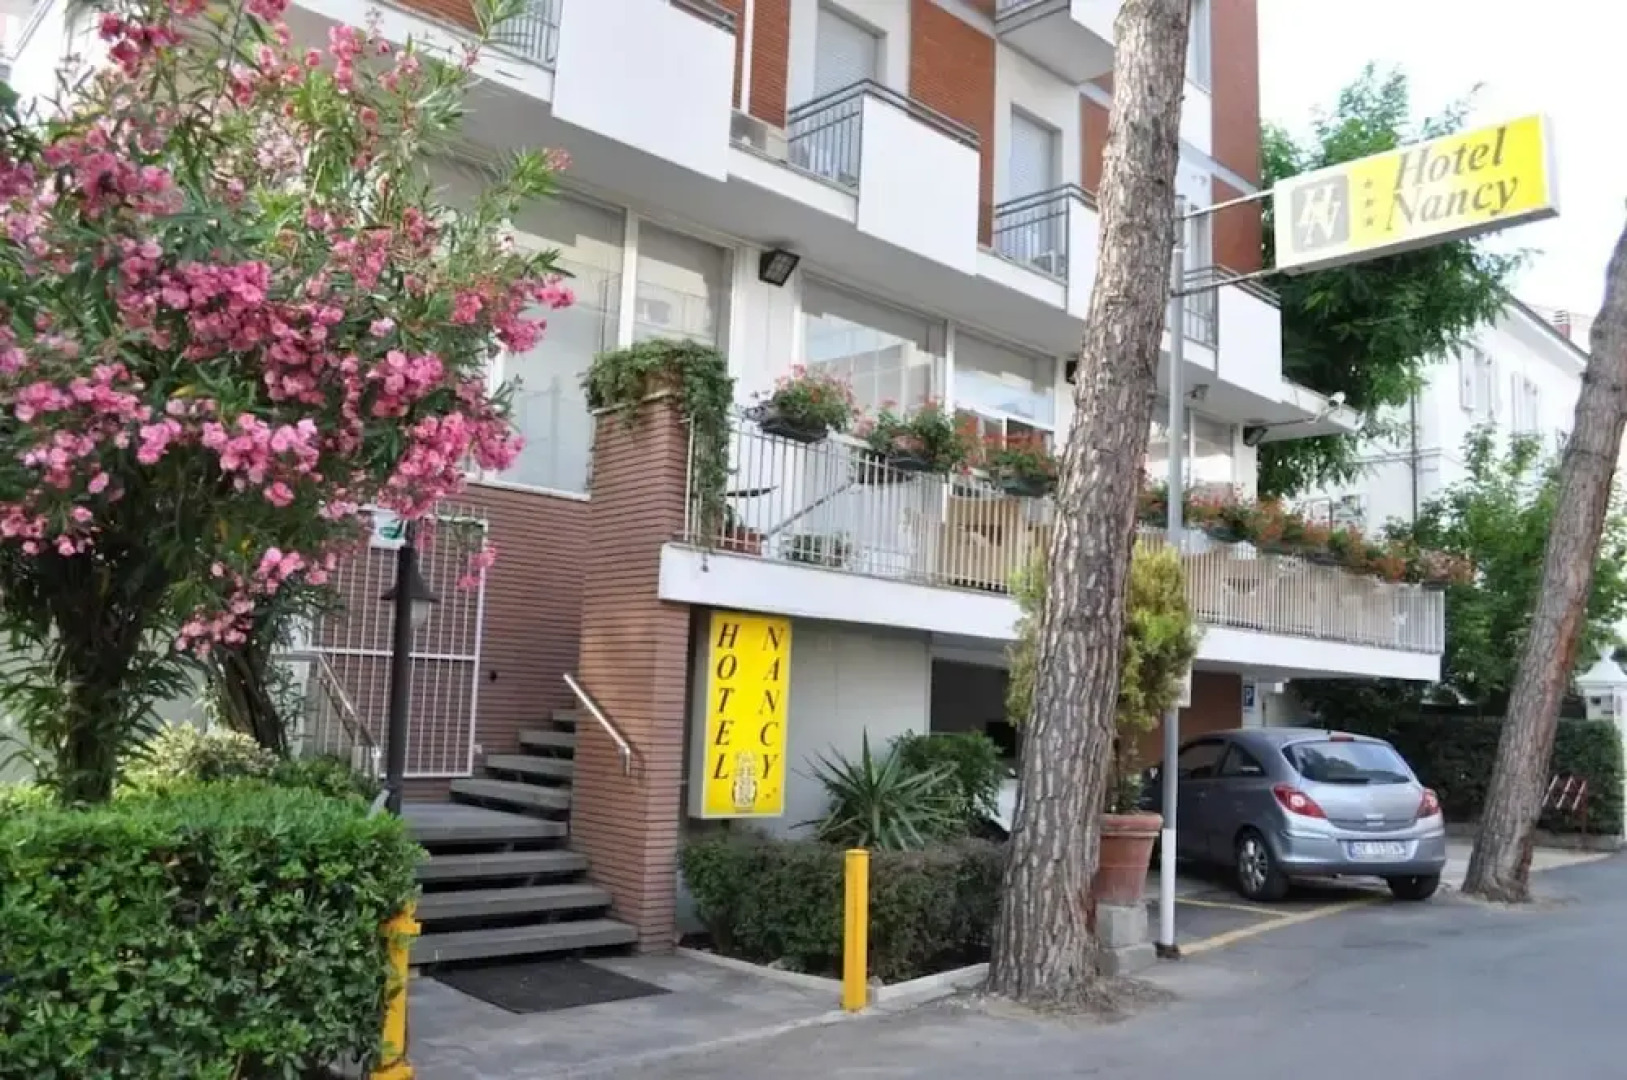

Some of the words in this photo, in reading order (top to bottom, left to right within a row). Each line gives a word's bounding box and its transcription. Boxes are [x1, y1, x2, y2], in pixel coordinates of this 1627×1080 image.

[1385, 175, 1519, 231] Nancy
[1393, 126, 1507, 191] Hotel
[712, 622, 740, 781] HOTEL
[758, 625, 784, 781] NANCY
